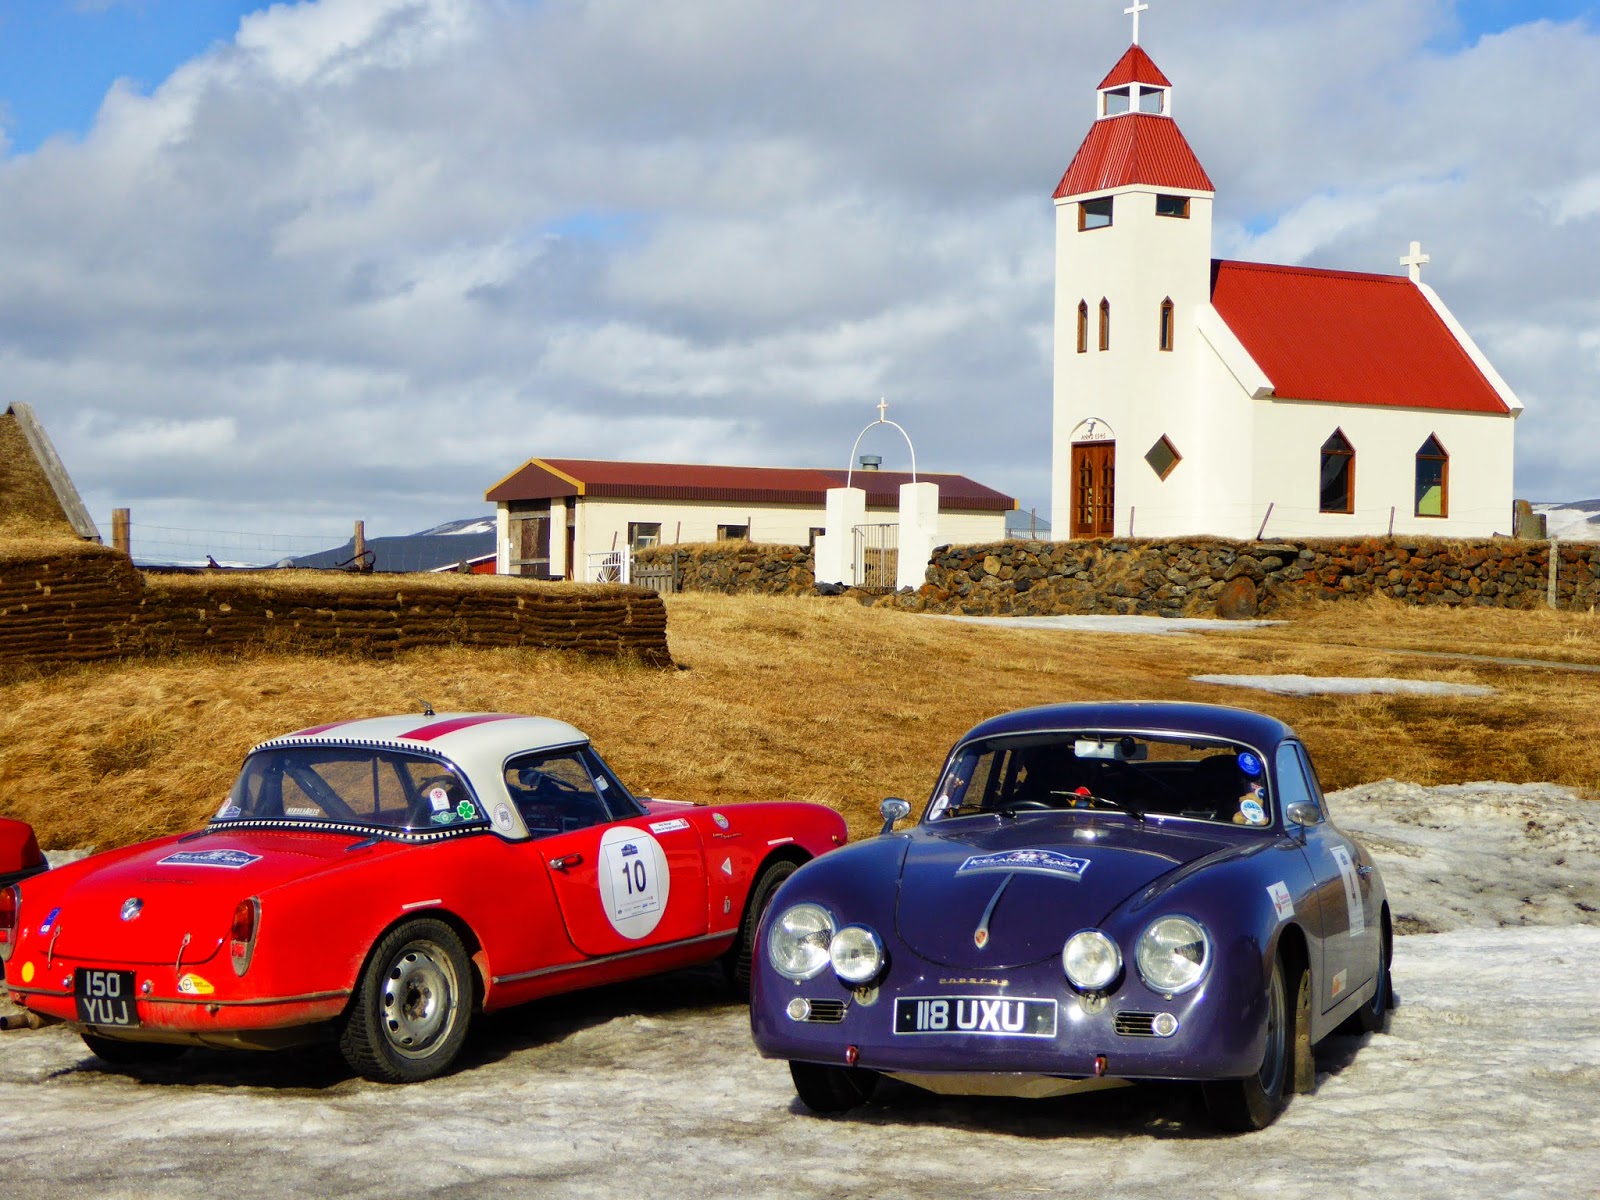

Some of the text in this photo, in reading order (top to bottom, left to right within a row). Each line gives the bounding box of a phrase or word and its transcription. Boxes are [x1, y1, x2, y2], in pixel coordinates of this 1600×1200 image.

[622, 859, 647, 895] 10
[970, 857, 1039, 866] ICELANDIC
[1043, 858, 1080, 869] SAGA
[86, 970, 121, 998] 150
[939, 978, 1009, 986] PORSCHE
[83, 997, 129, 1025] YUJ
[916, 1000, 1025, 1031] 118 UXU
